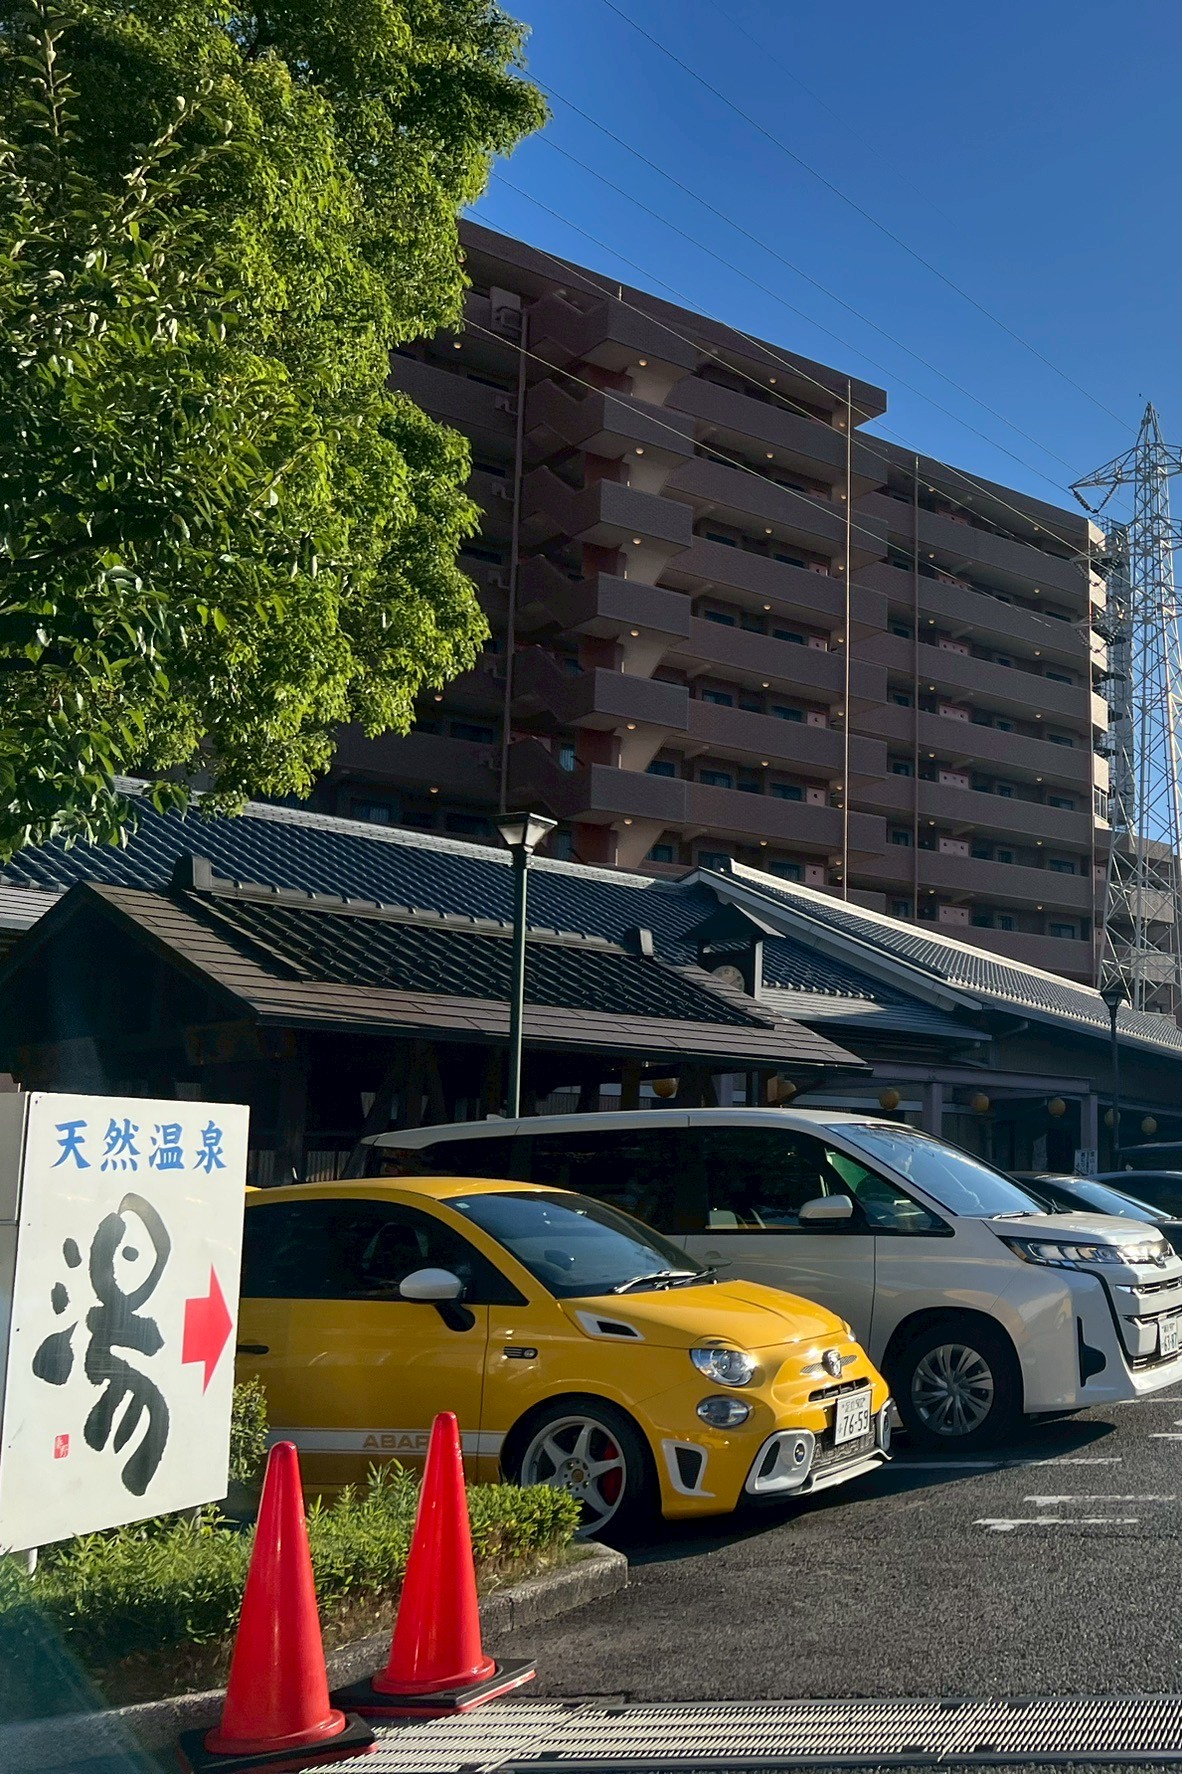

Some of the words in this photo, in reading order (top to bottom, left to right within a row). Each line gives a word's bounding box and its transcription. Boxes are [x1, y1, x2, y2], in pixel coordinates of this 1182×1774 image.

[51, 1118, 227, 1172] 天然温泉
[32, 1192, 172, 1497] 湯
[361, 1434, 463, 1450] ABAR
[843, 1409, 869, 1438] 76-59
